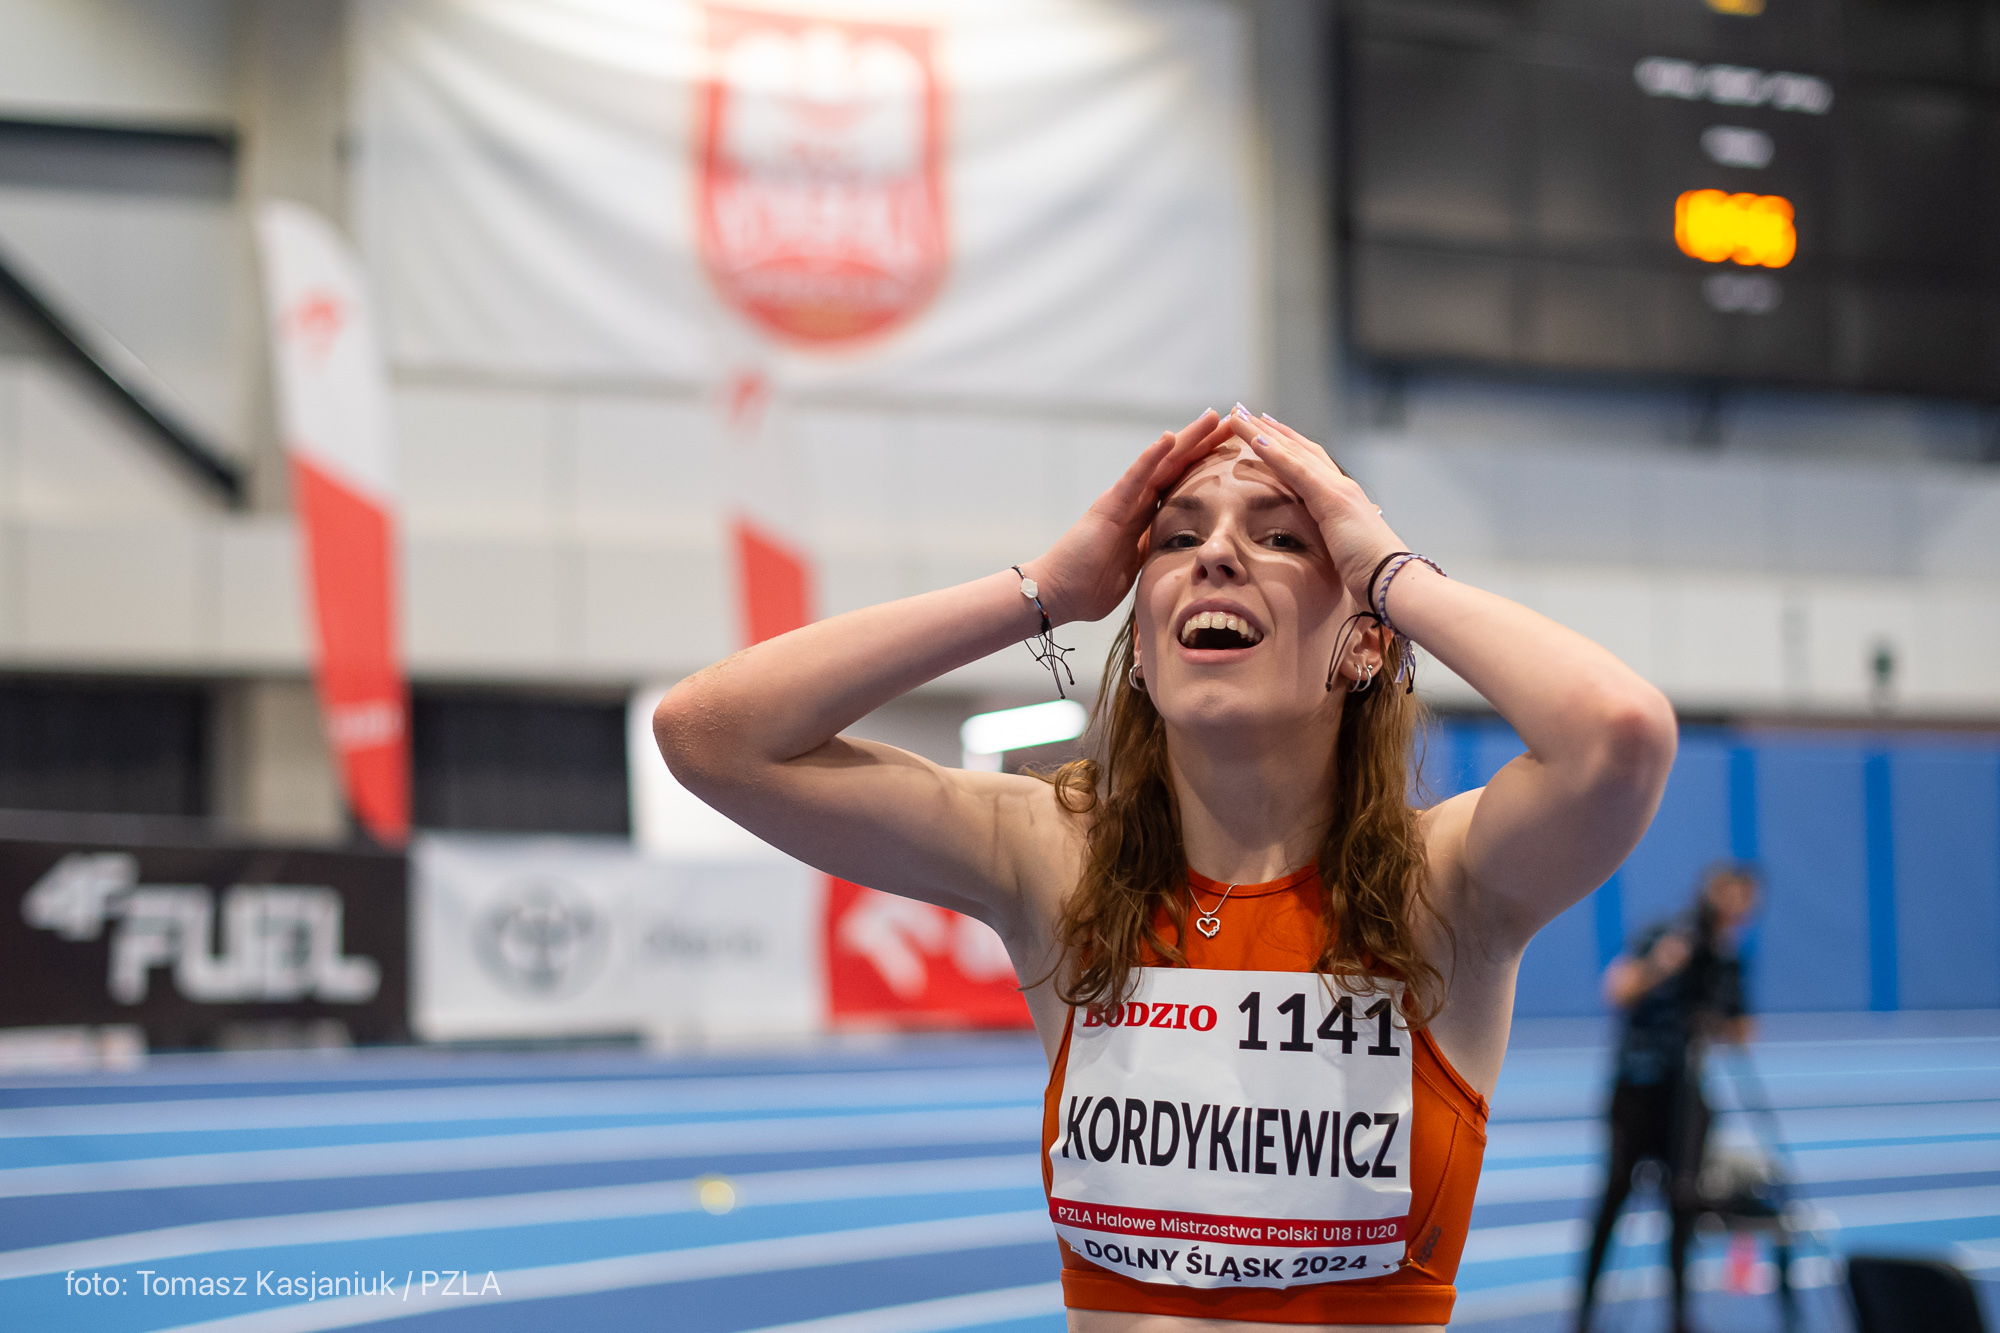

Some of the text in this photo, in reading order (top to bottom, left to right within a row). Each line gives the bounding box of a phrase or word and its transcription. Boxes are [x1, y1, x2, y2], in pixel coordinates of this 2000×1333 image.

[107, 882, 383, 1003] FUEL
[1082, 1001, 1218, 1032] BODZIO
[1238, 991, 1400, 1057] 1141
[1061, 1095, 1400, 1179] KORDYKIEWICZ
[1058, 1206, 1397, 1242] PZLA Halowe Mistrzostwa Polski U18 i U20
[1083, 1238, 1367, 1283] DOLNY ŚLĄSK 2024
